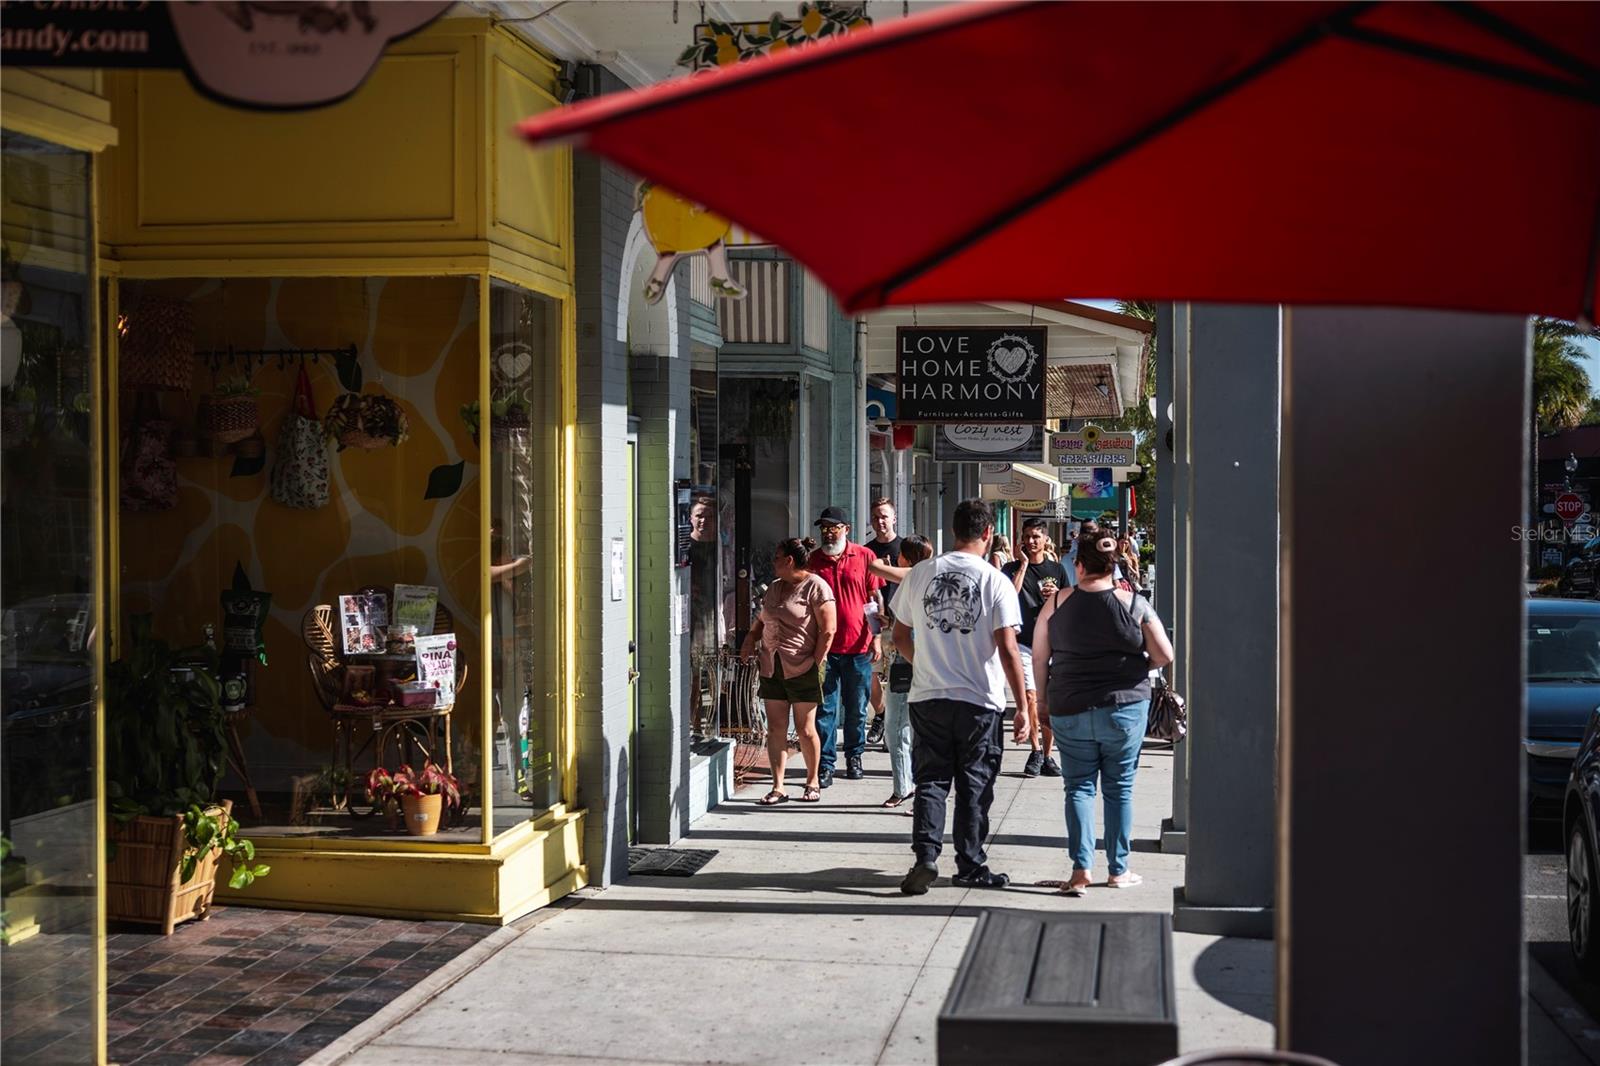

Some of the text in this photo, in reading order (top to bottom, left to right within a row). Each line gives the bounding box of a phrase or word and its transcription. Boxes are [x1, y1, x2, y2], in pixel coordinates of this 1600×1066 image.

[902, 336, 969, 354] LOVE
[902, 359, 981, 377] HOME
[902, 382, 1040, 400] HARMONY
[954, 424, 1024, 436] Cozy nest
[1058, 453, 1127, 464] TREASURES
[1557, 501, 1582, 512] STOP
